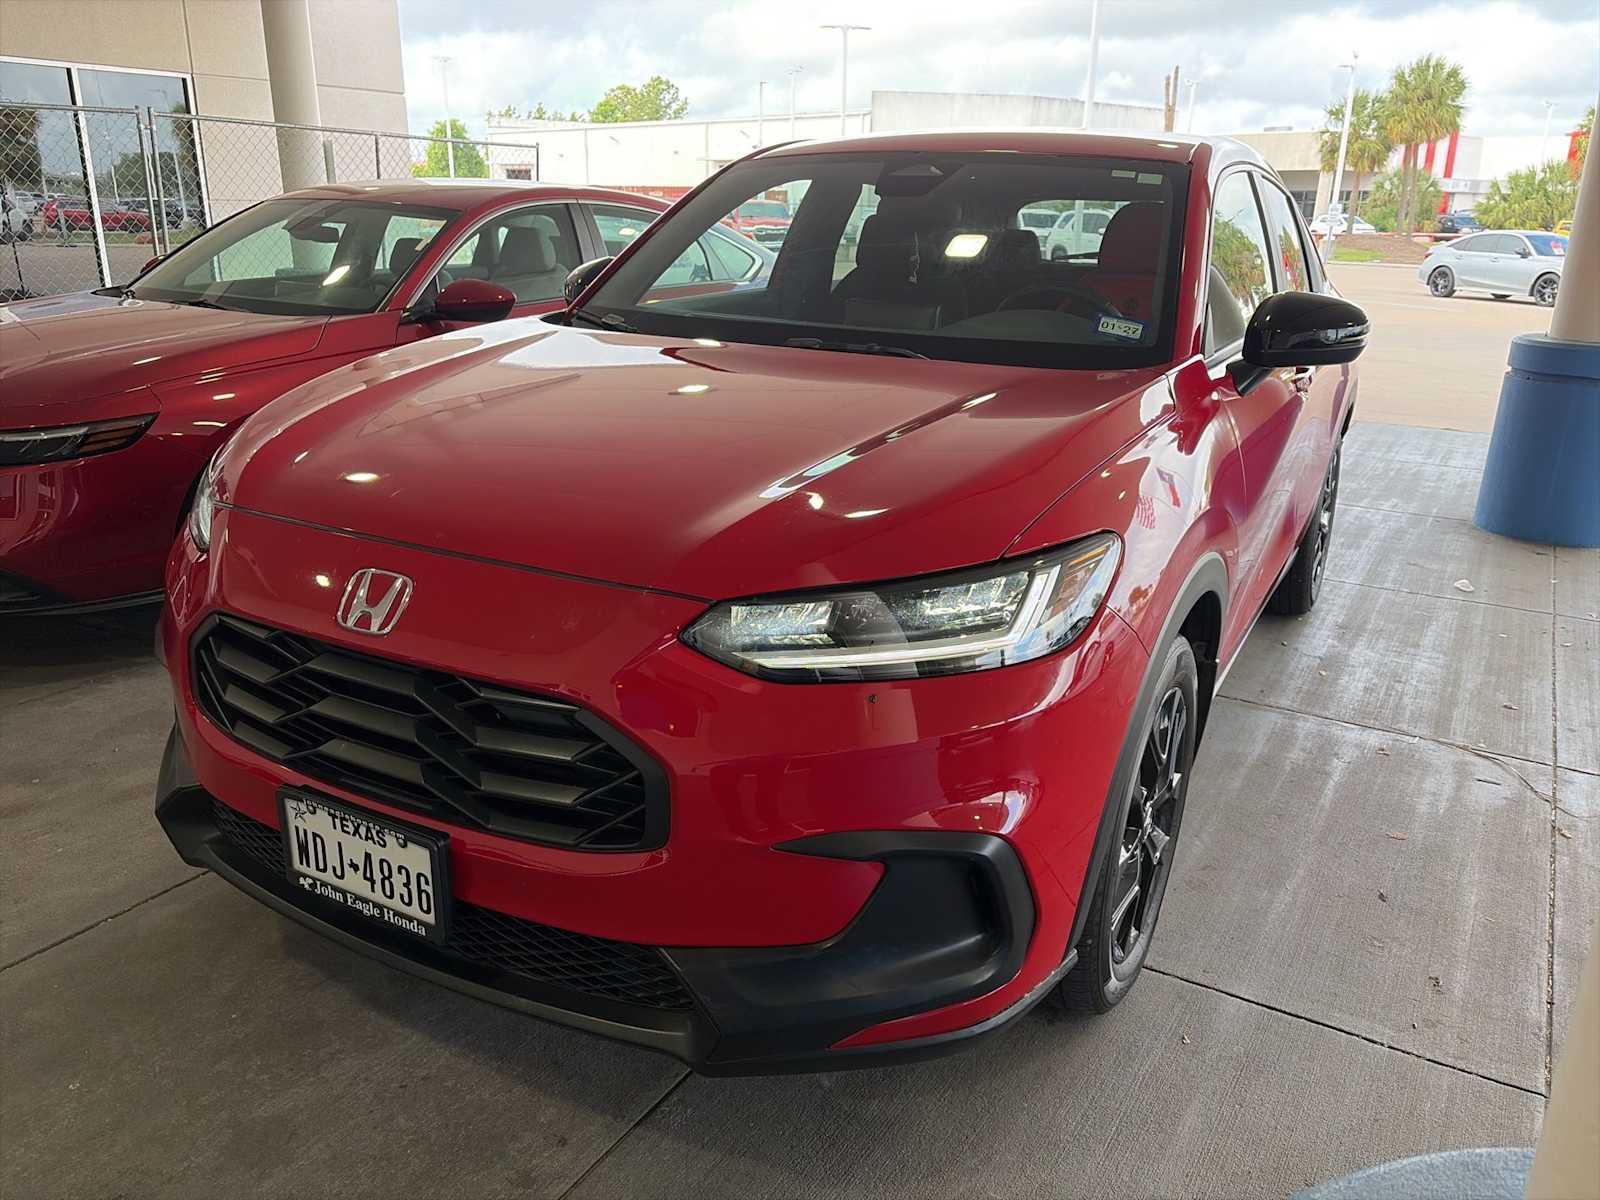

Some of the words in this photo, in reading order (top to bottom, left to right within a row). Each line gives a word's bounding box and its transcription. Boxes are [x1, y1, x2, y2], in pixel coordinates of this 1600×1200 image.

[327, 810, 387, 848] TEXAS
[314, 880, 344, 903] John
[346, 893, 381, 918] Eagle
[383, 908, 427, 936] Honda
